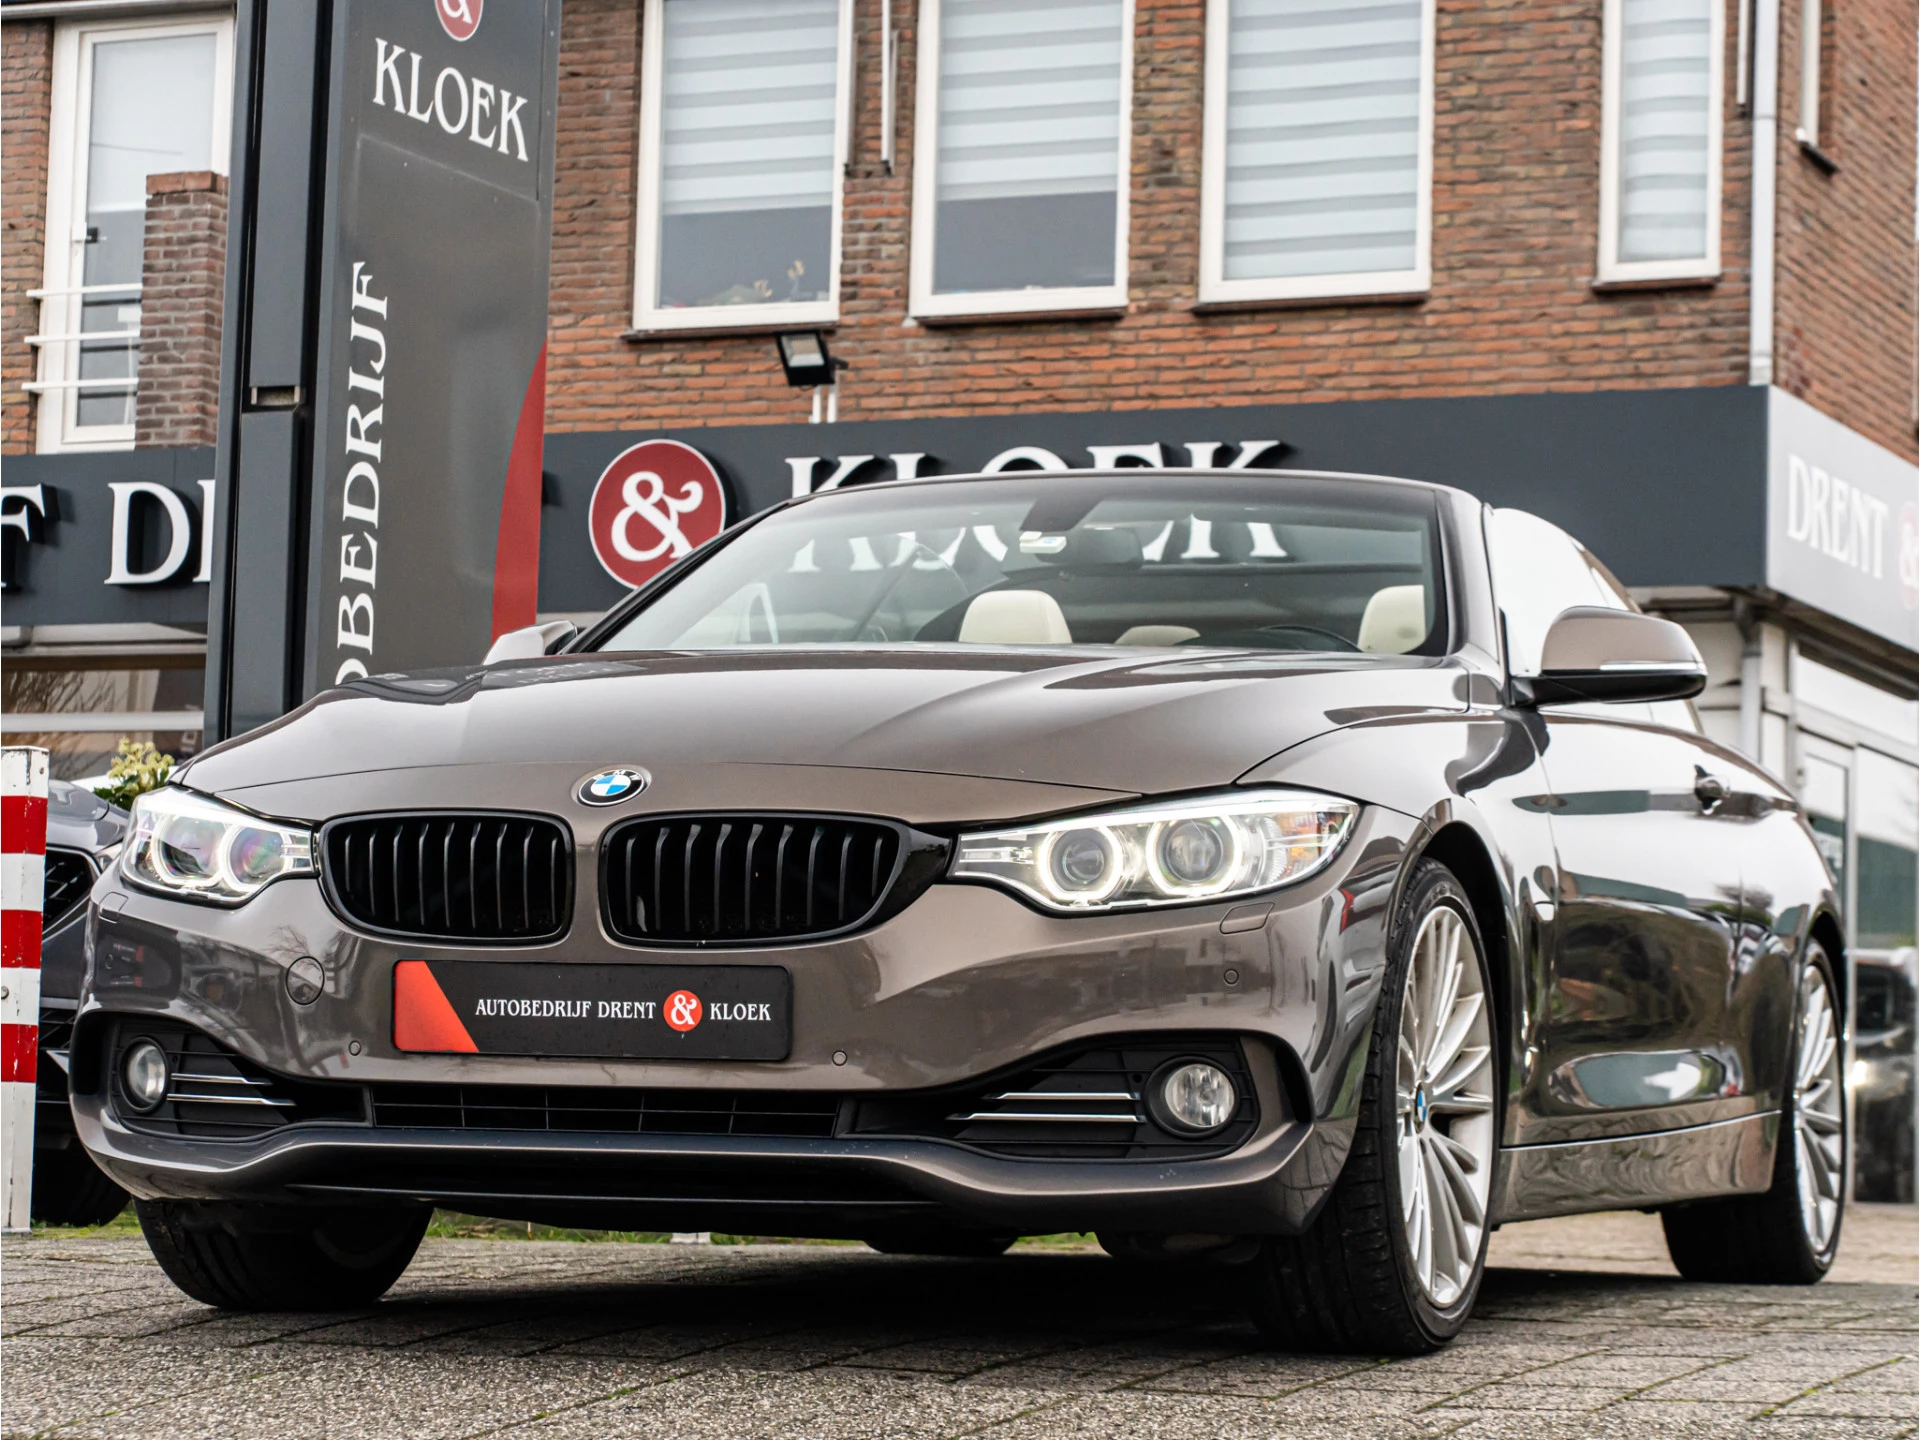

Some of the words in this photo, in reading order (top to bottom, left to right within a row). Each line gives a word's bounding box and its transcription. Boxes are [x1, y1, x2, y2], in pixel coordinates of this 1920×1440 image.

[372, 38, 529, 163] KLOEK
[1787, 453, 1889, 580] DRENT
[475, 999, 592, 1018] AUTOBEDRIJF
[597, 1001, 656, 1019] DRENT
[670, 994, 698, 1026] &
[710, 1003, 771, 1021] KLOEK
